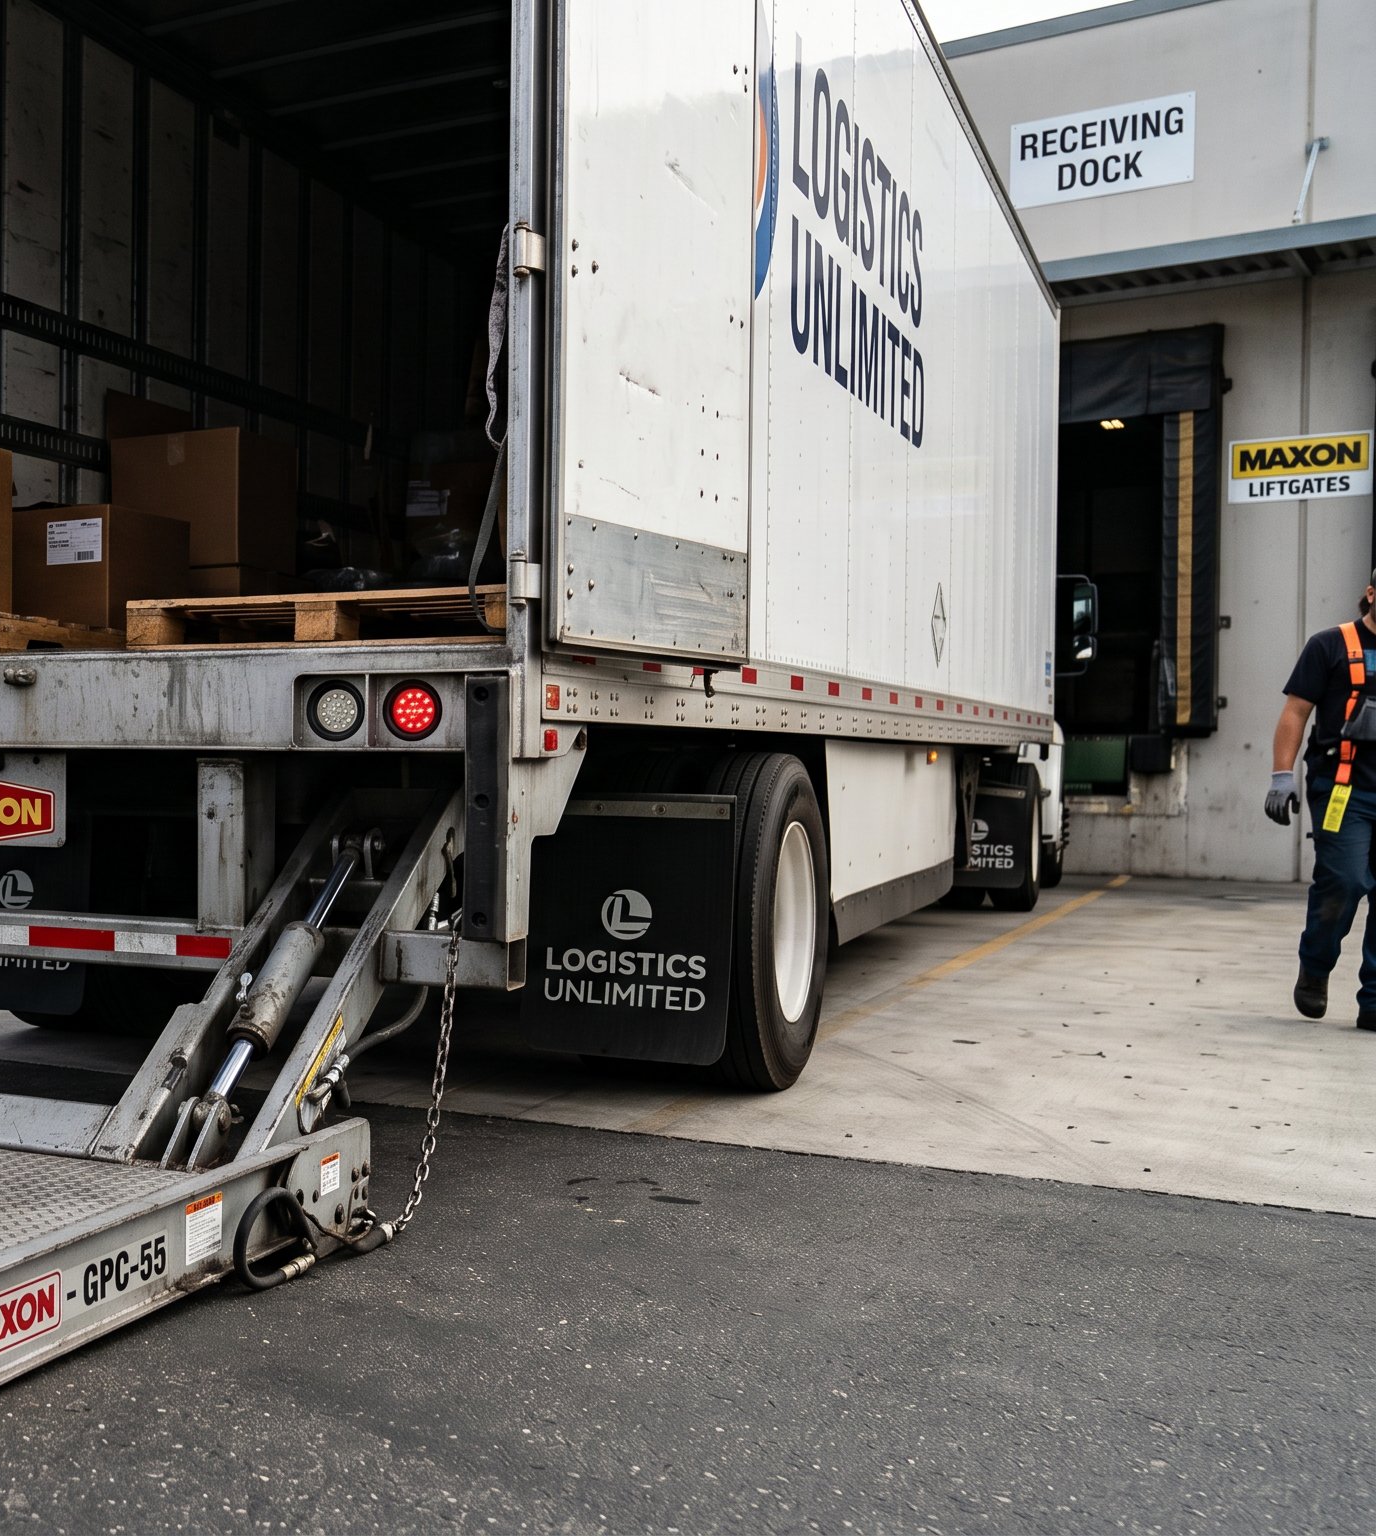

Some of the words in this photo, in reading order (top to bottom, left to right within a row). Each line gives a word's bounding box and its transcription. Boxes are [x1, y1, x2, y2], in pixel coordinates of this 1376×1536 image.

[1020, 106, 1184, 161] RECEIVING
[792, 32, 922, 328] LOGISTICS
[1057, 150, 1143, 191] DOCK
[790, 214, 924, 449] UNLIMITED
[1239, 441, 1362, 472] MAXON
[1248, 475, 1350, 498] LIFTGATES
[969, 857, 1014, 869] MITED
[971, 844, 1014, 856] STICS
[545, 947, 707, 980] LOGISTICS
[544, 977, 706, 1012] UNLIMITED
[83, 1235, 167, 1307] GPC-55
